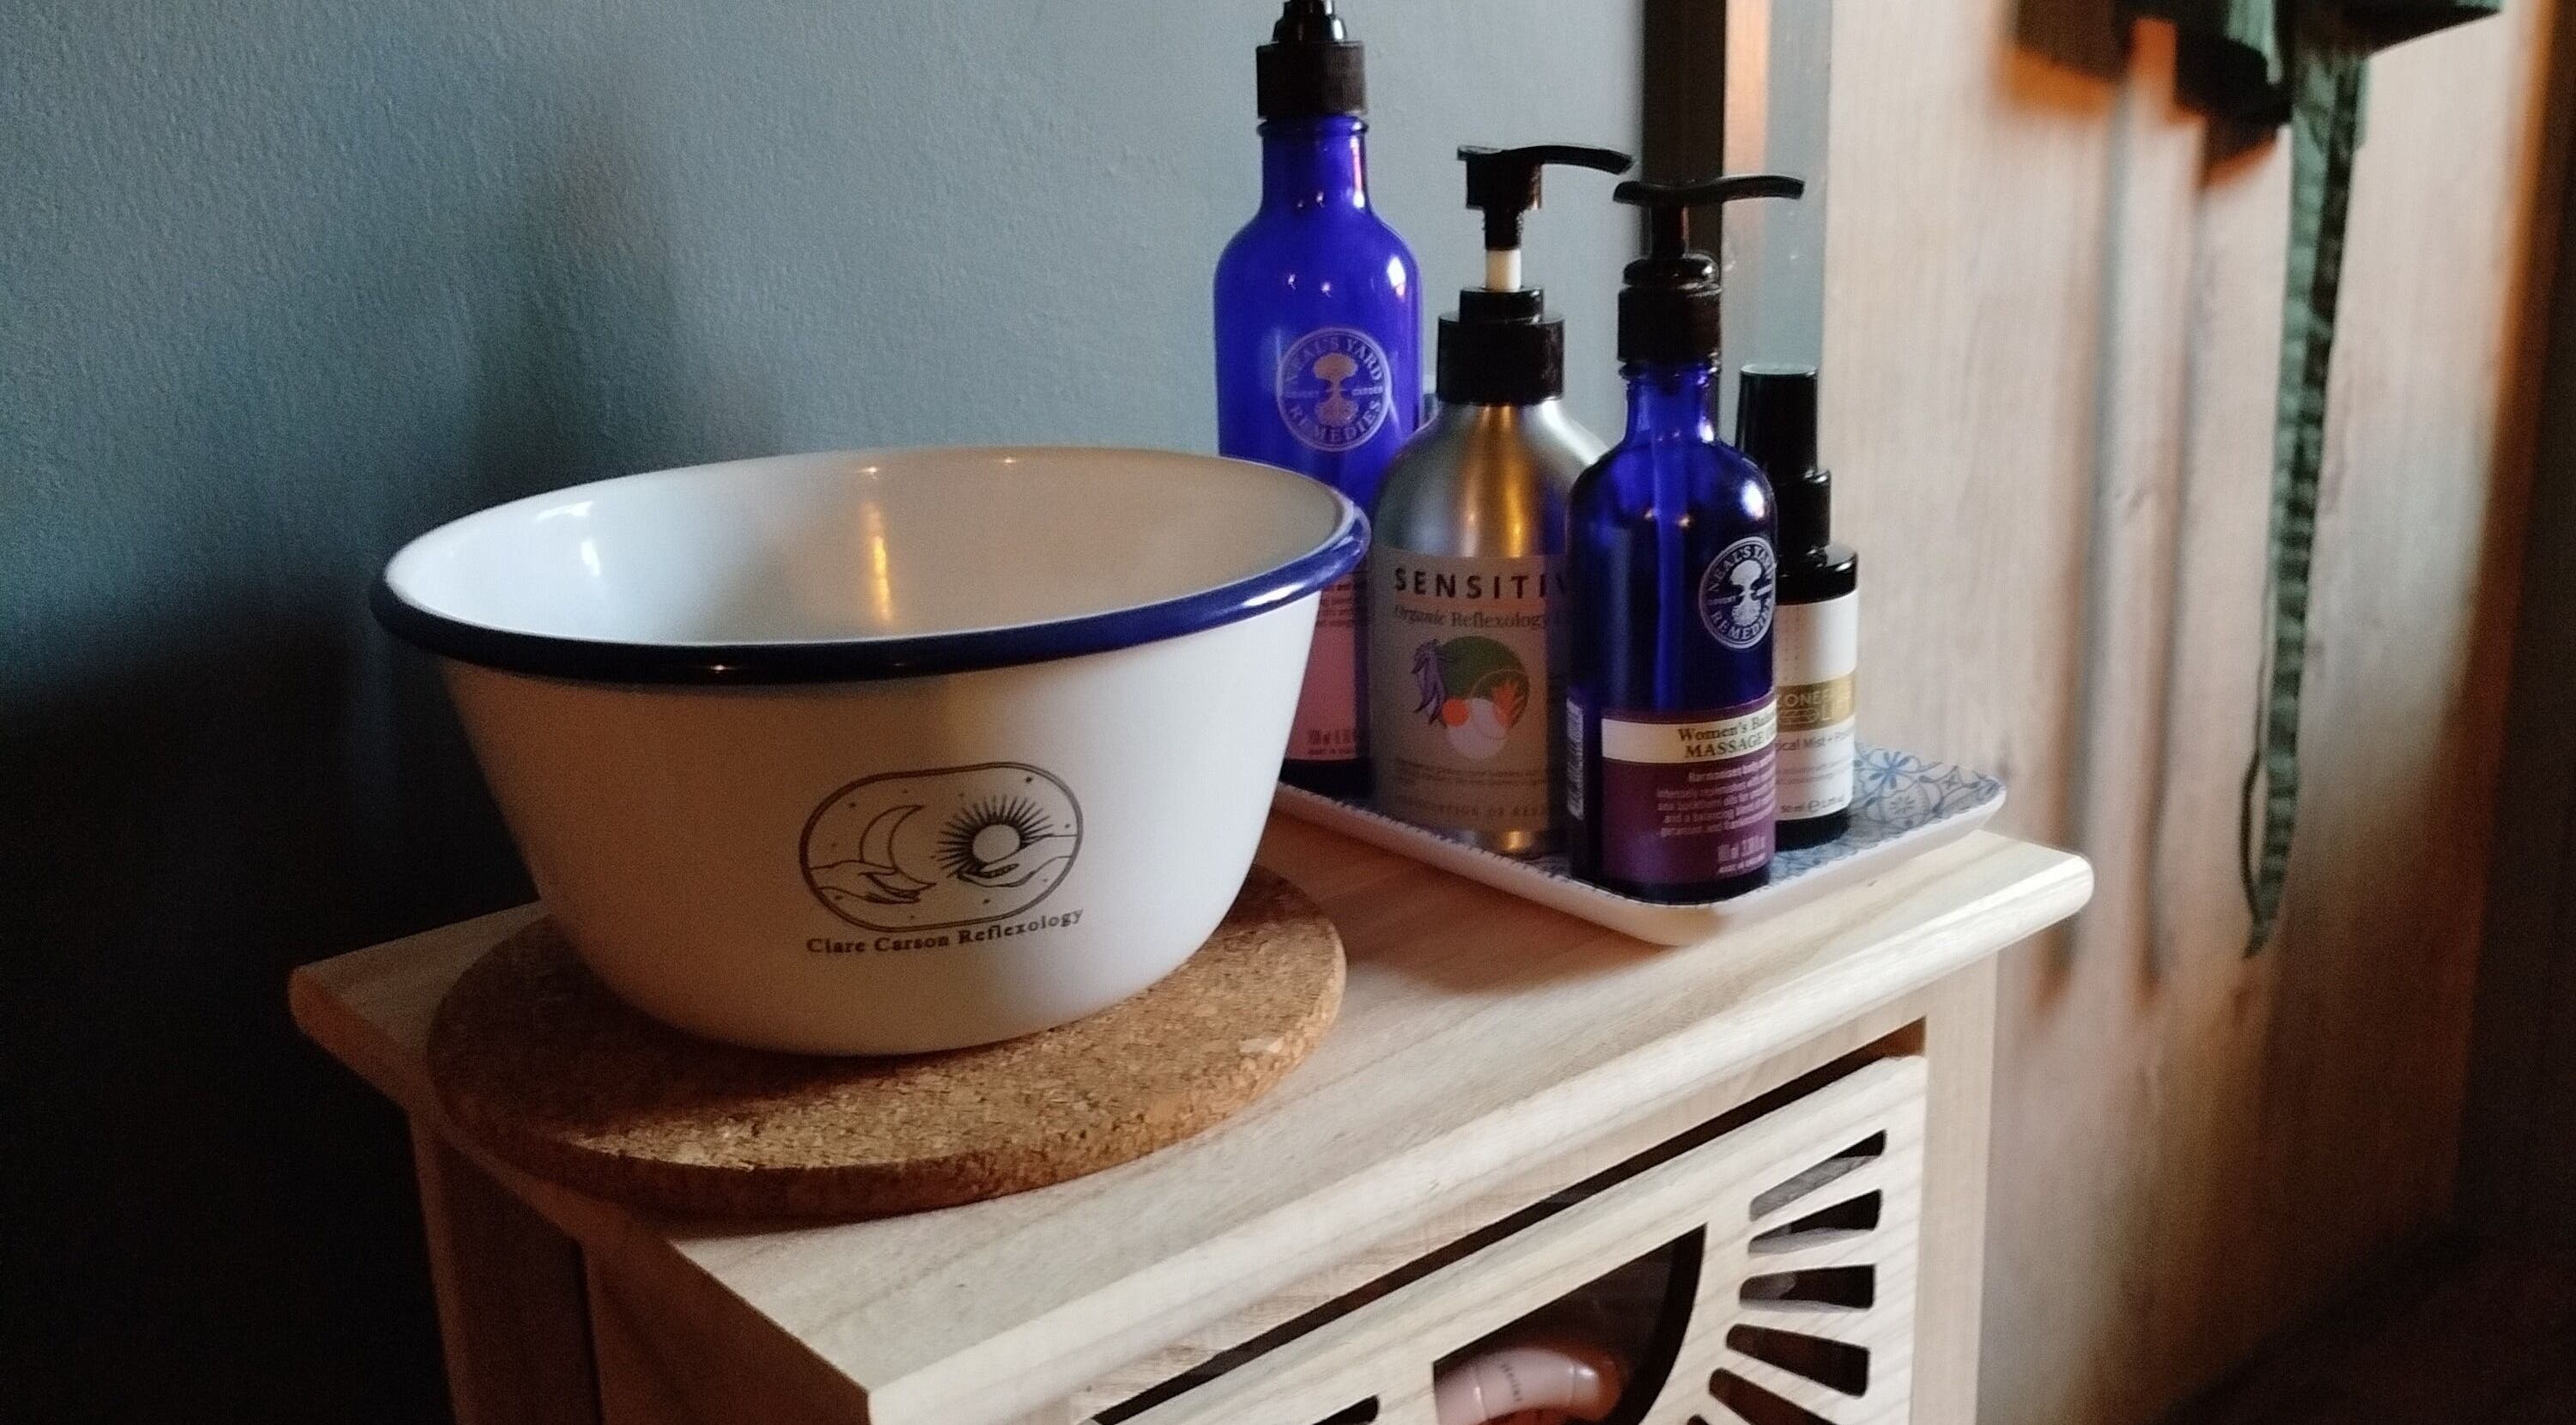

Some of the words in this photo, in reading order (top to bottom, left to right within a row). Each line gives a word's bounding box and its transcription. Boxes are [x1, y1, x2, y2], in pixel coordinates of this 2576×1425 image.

[1347, 338, 1382, 381] YARD
[1289, 400, 1382, 442] REMEDIES
[1707, 545, 1753, 593] NEAL'S
[1394, 604, 1445, 628] Organic
[1677, 721, 1748, 742] Women's
[1684, 731, 1765, 758] MASSAGE
[806, 936, 866, 954] Clare
[874, 935, 950, 952] Carson
[957, 908, 1084, 945] Reflexology
